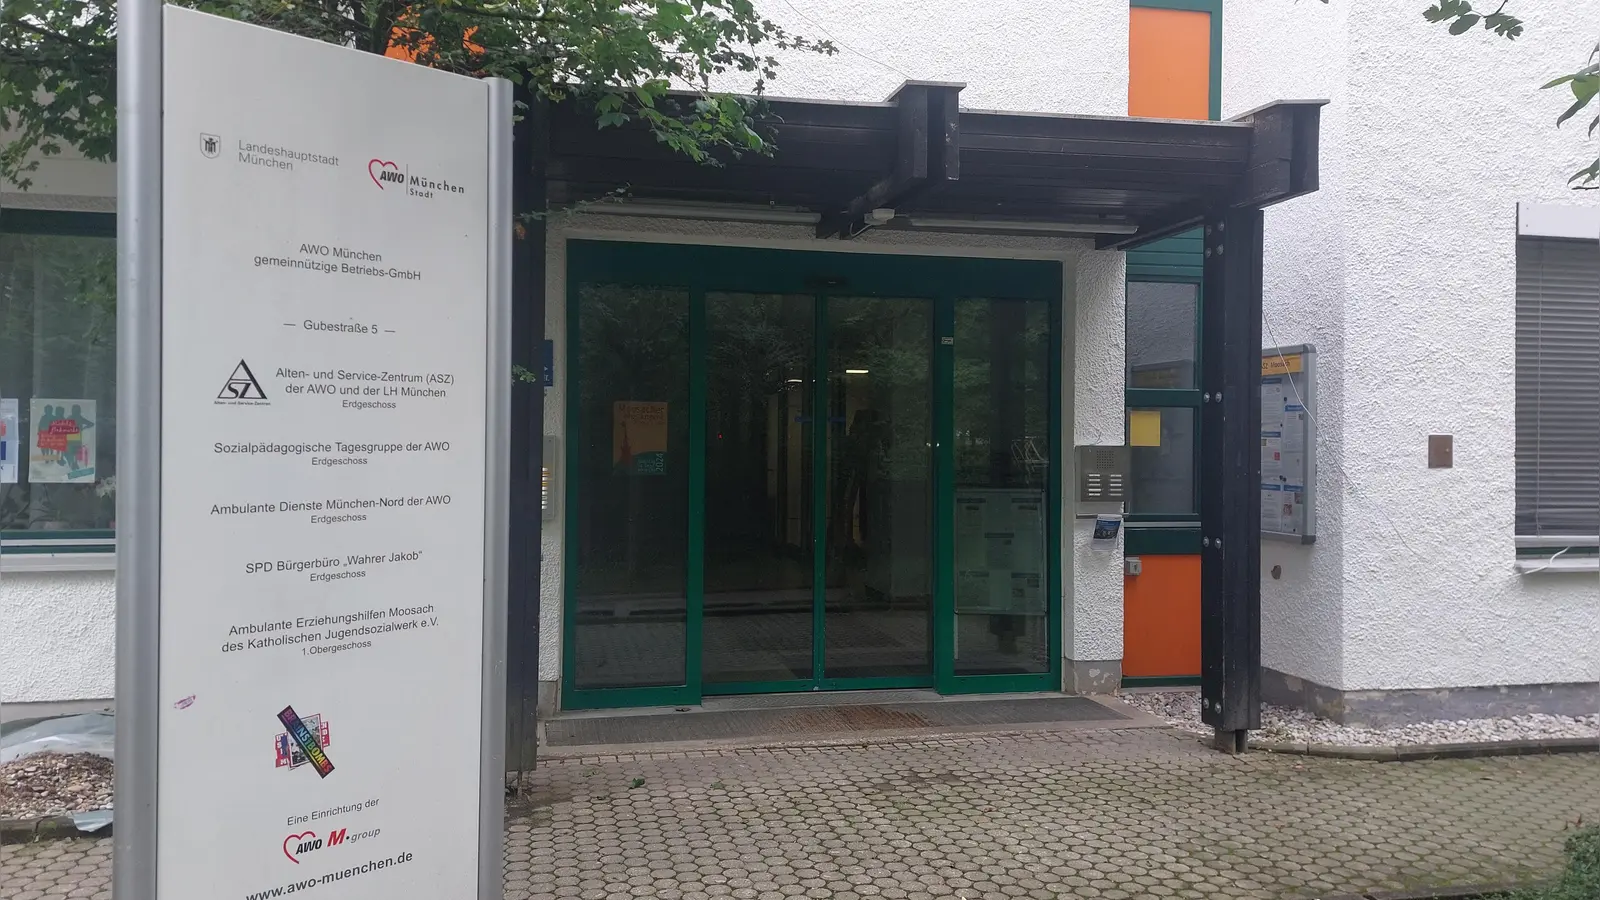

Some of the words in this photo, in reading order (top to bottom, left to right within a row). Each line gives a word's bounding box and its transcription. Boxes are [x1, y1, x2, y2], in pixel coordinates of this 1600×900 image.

[238, 140, 339, 167] Landeshauptstadt
[239, 151, 293, 170] München
[380, 170, 404, 183] AWO
[409, 176, 465, 194] München
[410, 188, 433, 198] Stadt
[300, 244, 329, 256] AWO
[333, 247, 382, 262] München
[254, 256, 338, 274] gemeinnützige
[342, 263, 420, 280] Betriebs-GmbH
[304, 320, 368, 333] Gubestraße
[372, 324, 378, 334] 5
[276, 368, 310, 378] Alten-
[313, 370, 333, 379] und
[338, 370, 422, 382] Service-Zentrum
[426, 374, 454, 386] (ASZ)
[285, 384, 304, 393] der
[307, 384, 336, 394] AWO
[340, 386, 359, 395] und
[363, 386, 380, 395] der
[384, 386, 397, 396] LH
[401, 387, 446, 397] München
[342, 400, 396, 410] Erdgeschoss
[214, 442, 331, 455] Sozialpädagogische
[335, 442, 403, 454] Tagesgruppe
[406, 442, 422, 451] der
[424, 442, 450, 451] AWO
[312, 457, 367, 467] Erdgeschoss
[210, 503, 275, 515] Ambulante
[280, 501, 322, 512] Dienste
[326, 497, 404, 509] München-Nord
[407, 496, 424, 506] der
[425, 495, 451, 505] AWO
[311, 514, 366, 524] Erdgeschoss
[246, 562, 272, 573] SPD
[277, 557, 340, 572] Bürgerbüro
[310, 571, 366, 582] Erdgeschoss
[229, 620, 292, 636] Ambulante
[297, 610, 386, 628] Erziehungshilfen
[389, 604, 433, 617] Moosach
[222, 642, 243, 652] des
[248, 633, 321, 649] Katholischen
[325, 620, 418, 640] Jugendsozialwerk
[421, 616, 438, 627] e.V.
[288, 816, 308, 826] Eine
[312, 803, 362, 820] Einrichtung
[365, 799, 379, 808] der
[296, 839, 322, 855] AWO
[246, 852, 412, 900] www.awo-muenchen.de
